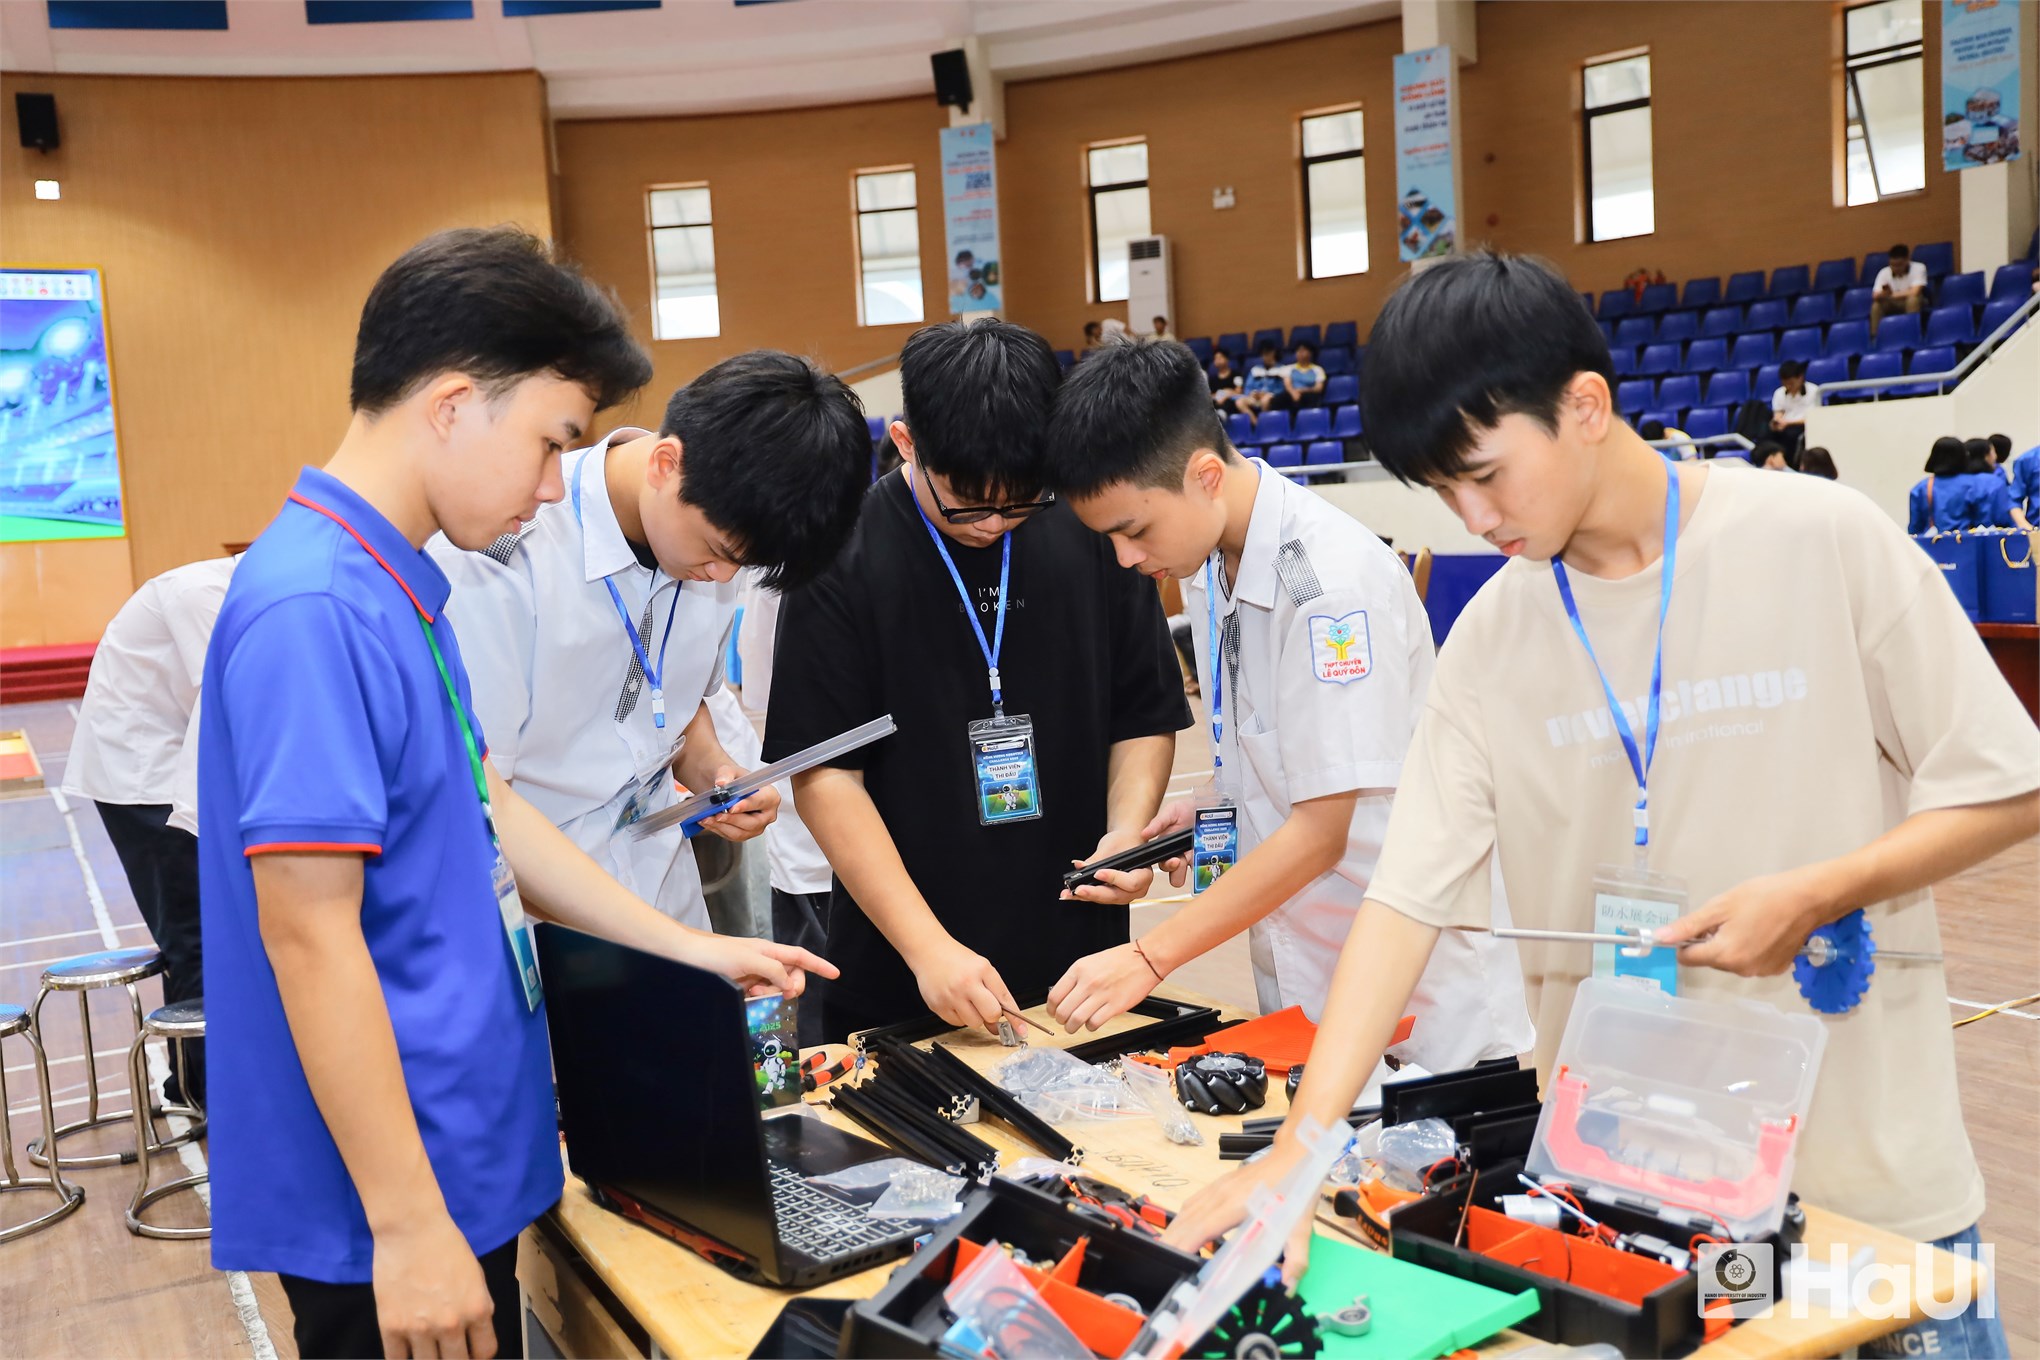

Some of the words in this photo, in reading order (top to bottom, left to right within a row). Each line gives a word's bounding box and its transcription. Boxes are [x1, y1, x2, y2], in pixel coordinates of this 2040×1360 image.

[959, 599, 1025, 612] BOKEN
[1339, 658, 1361, 666] CHUYÊN
[1323, 669, 1331, 678] LÊ
